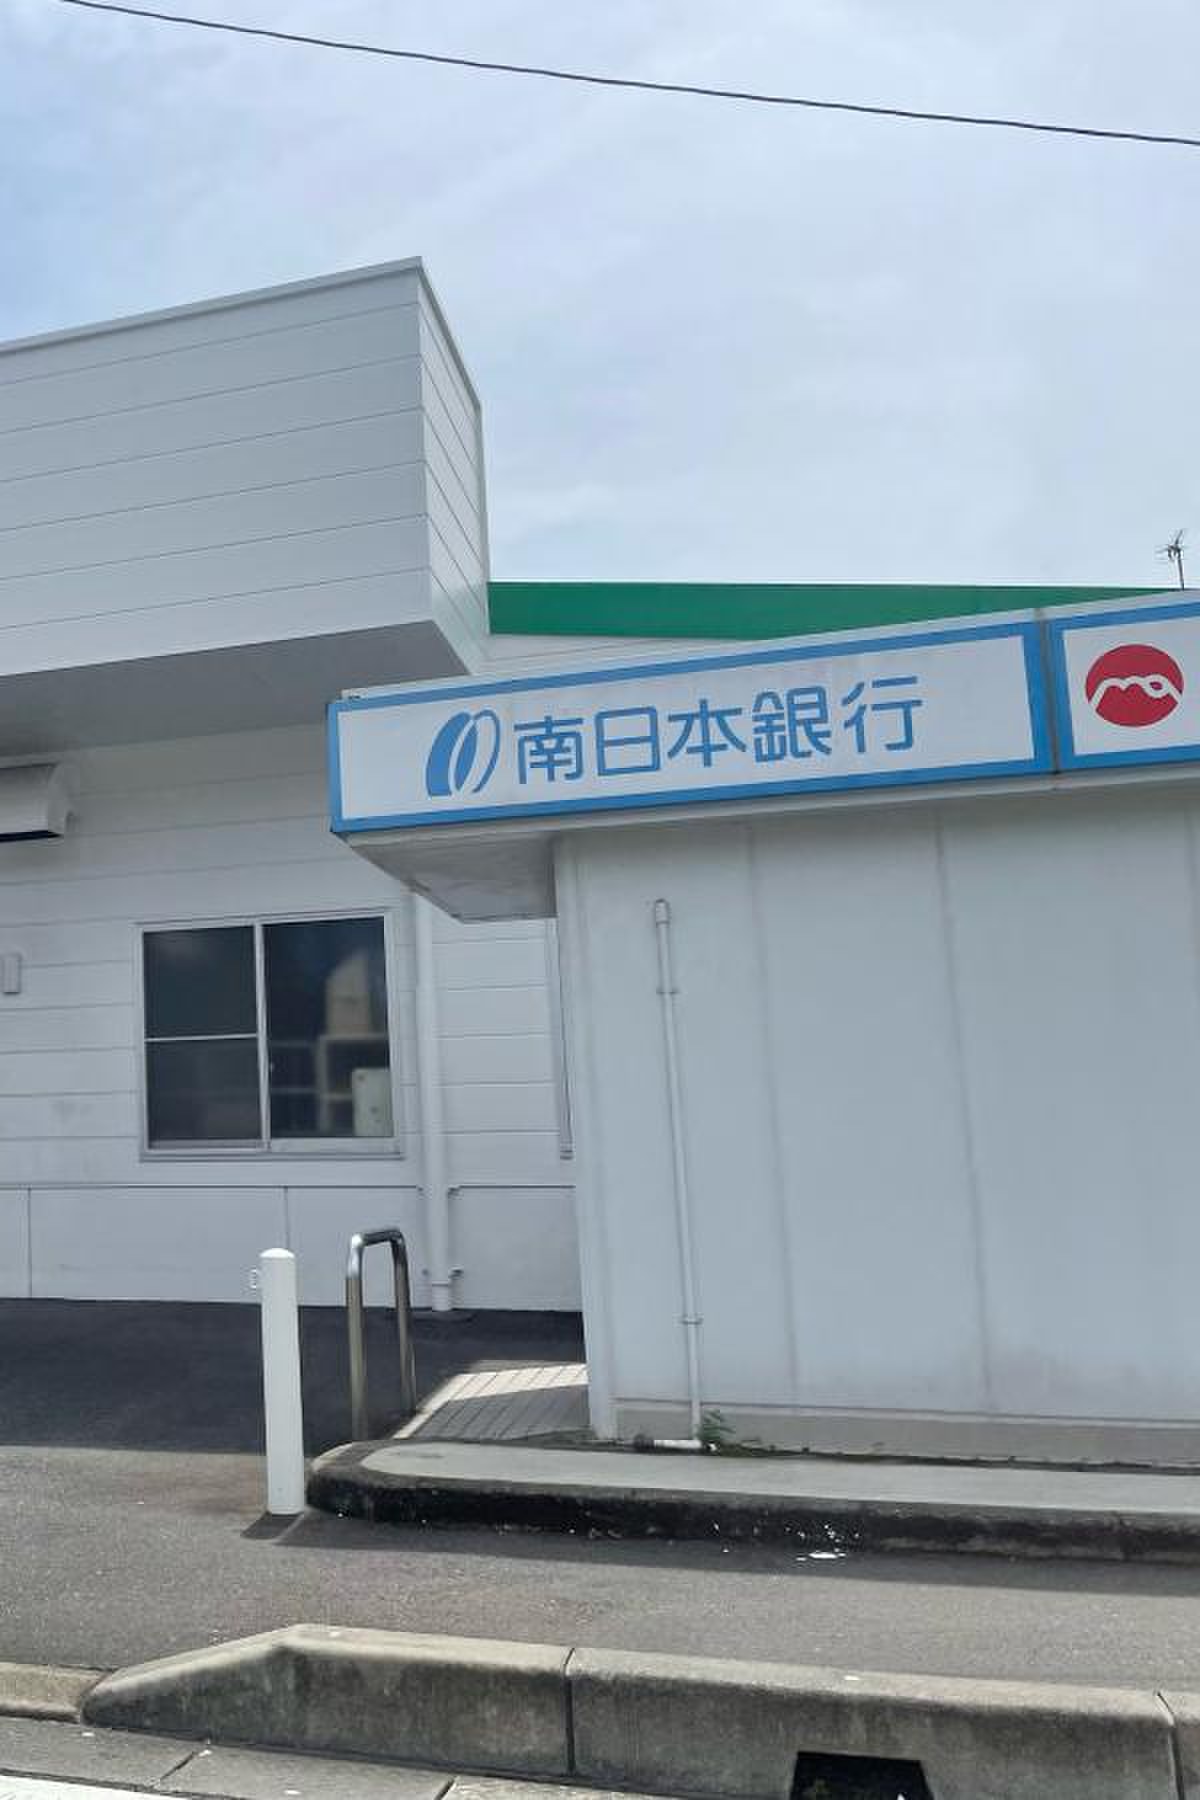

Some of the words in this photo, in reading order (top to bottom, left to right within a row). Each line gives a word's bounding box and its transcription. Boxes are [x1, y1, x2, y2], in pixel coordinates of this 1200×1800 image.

[513, 676, 923, 785] 南日本銀行
